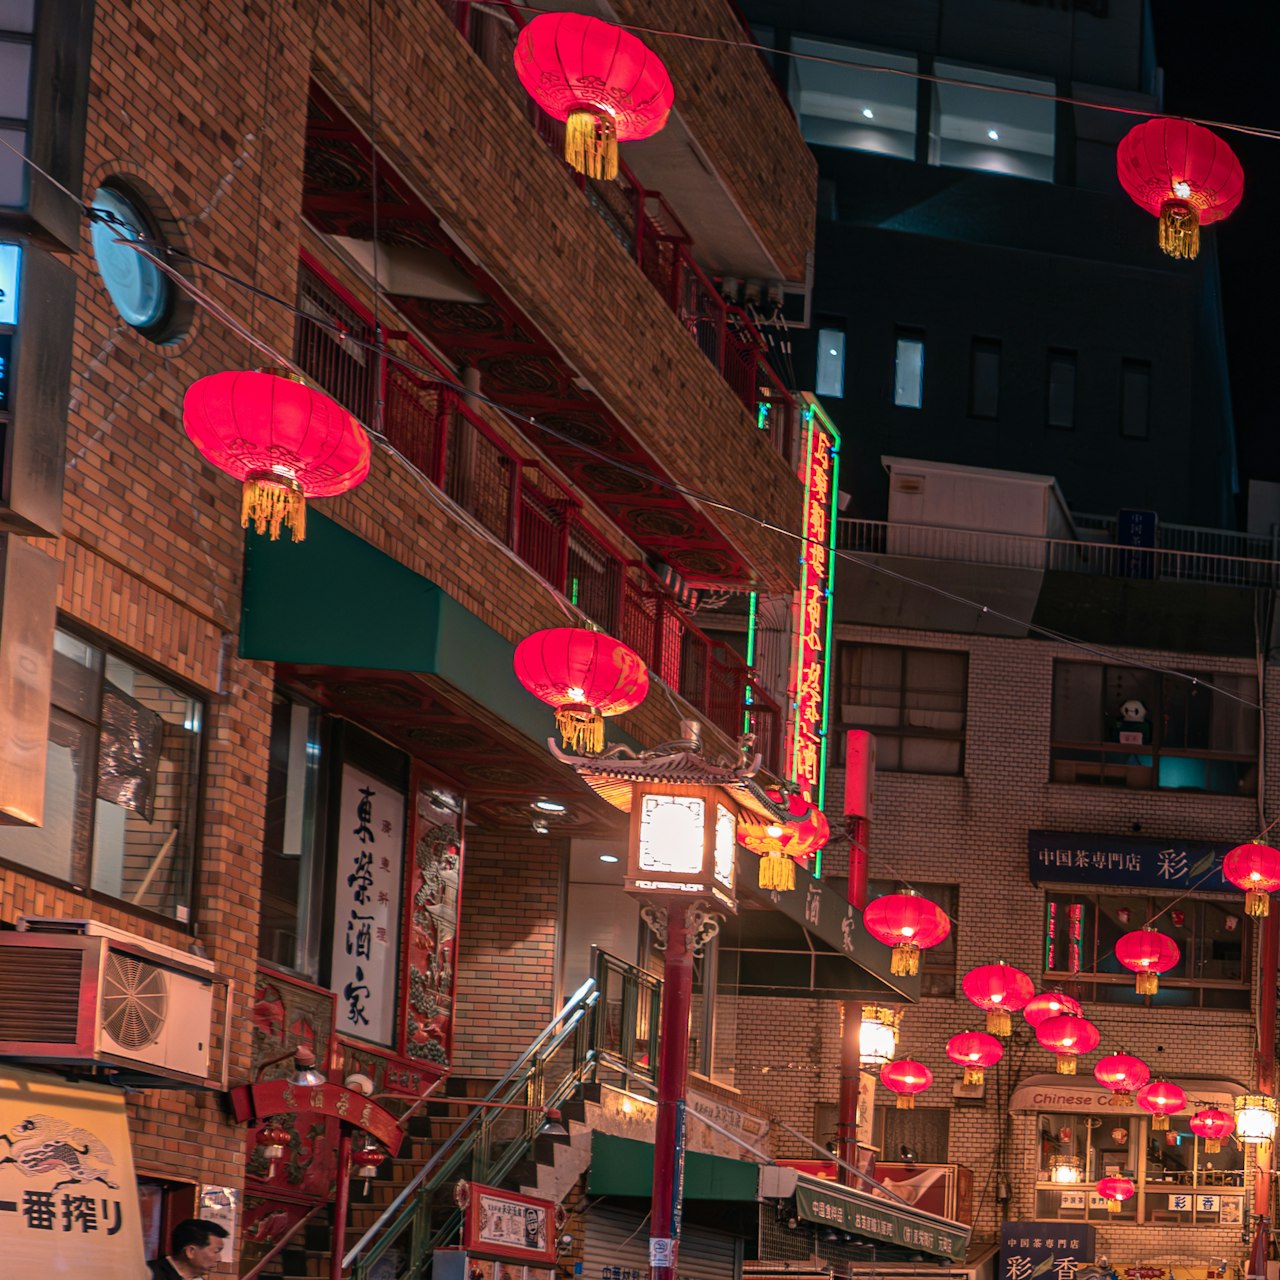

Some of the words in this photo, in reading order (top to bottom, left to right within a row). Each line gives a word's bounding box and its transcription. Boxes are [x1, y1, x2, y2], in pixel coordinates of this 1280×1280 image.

[1039, 848, 1141, 872] 中国茶専門店
[1033, 1092, 1092, 1106] Chinese
[1174, 1196, 1186, 1210] 彩
[1202, 1196, 1215, 1211] 香
[1007, 1238, 1080, 1250] 中国茶専門店
